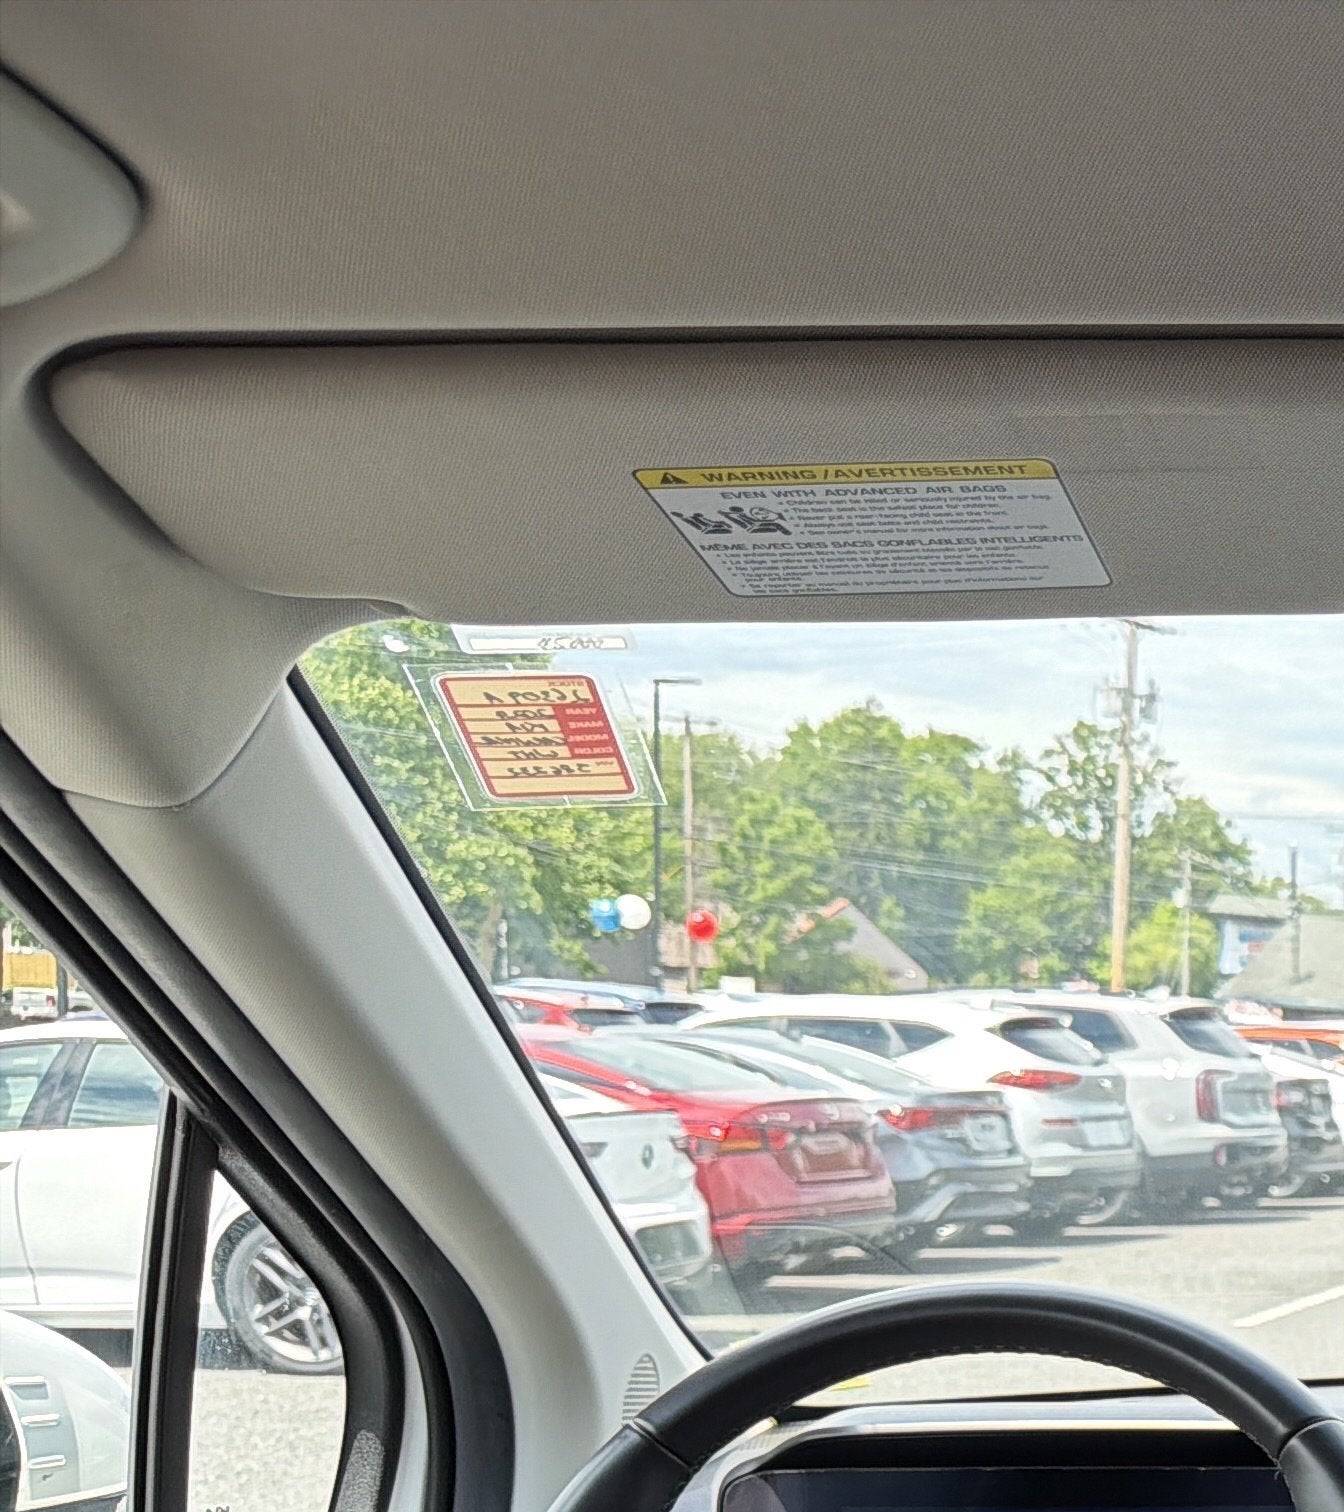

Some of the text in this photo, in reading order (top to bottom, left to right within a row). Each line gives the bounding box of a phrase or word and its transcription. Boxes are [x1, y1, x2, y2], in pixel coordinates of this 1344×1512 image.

[700, 469, 817, 483] WARNING
[720, 491, 767, 499] EVEN
[771, 489, 817, 498] WITH
[825, 487, 917, 497] ADVANCED
[959, 485, 1007, 493] BAGS
